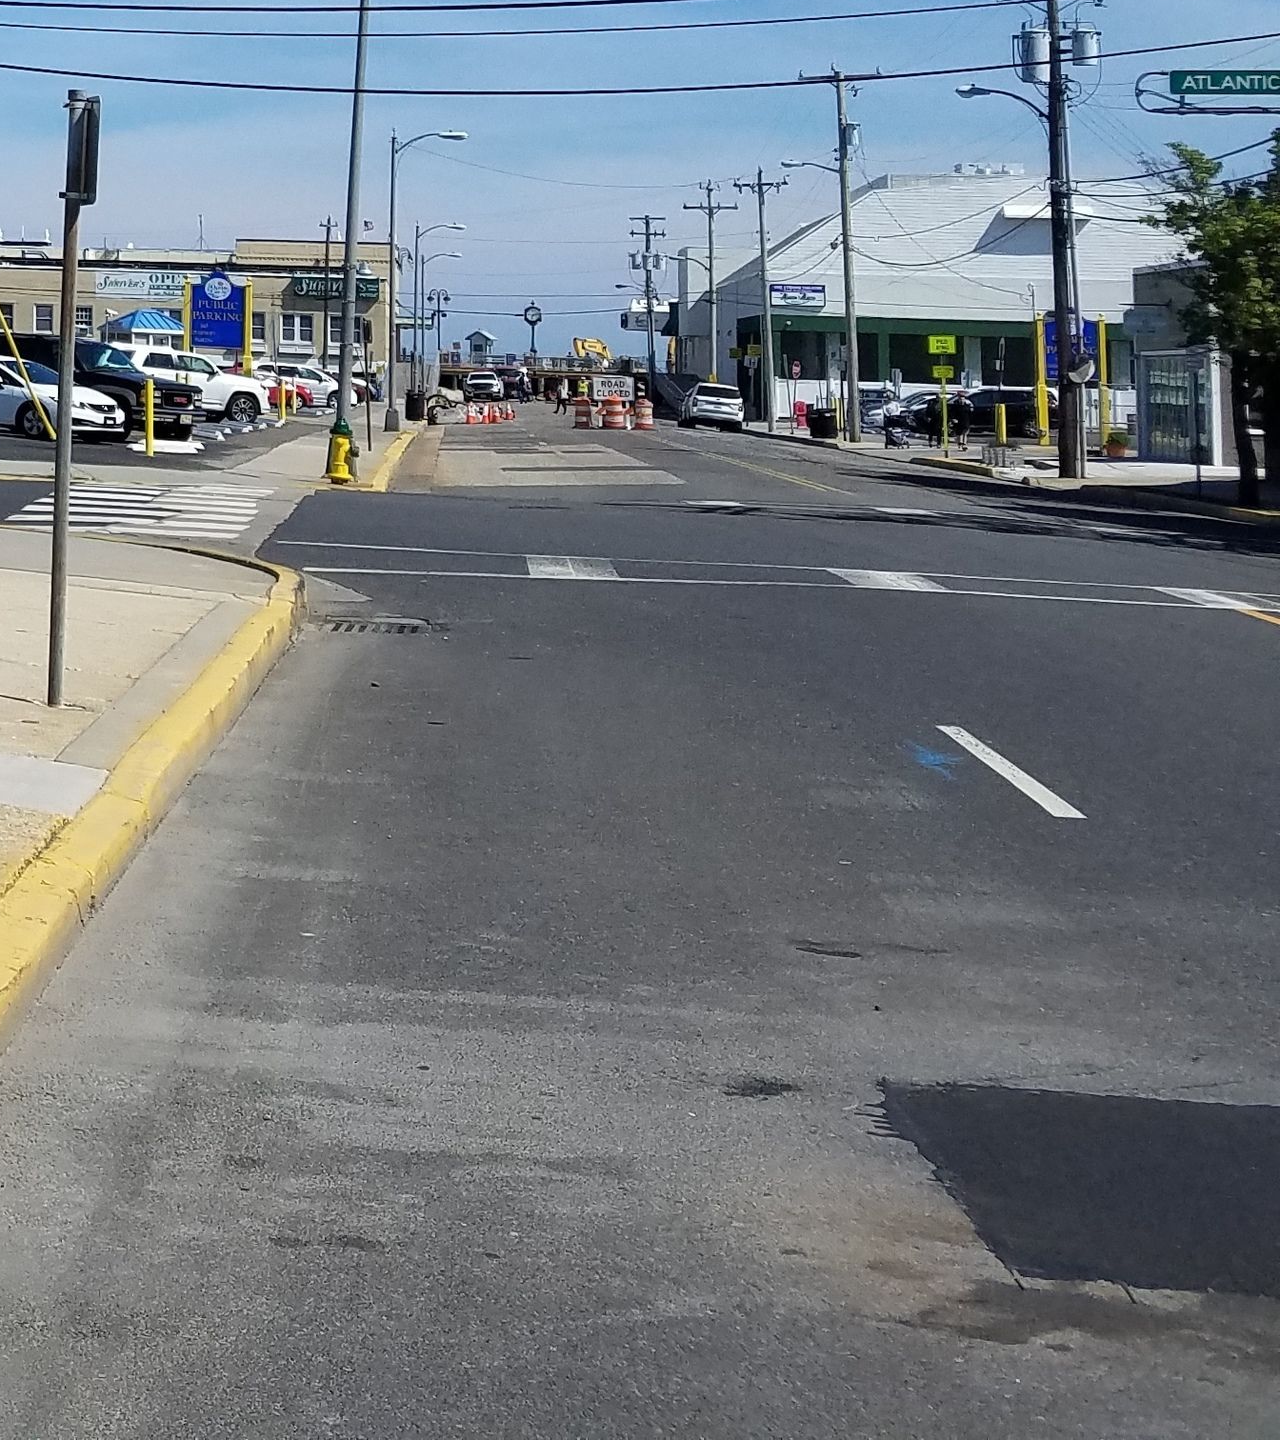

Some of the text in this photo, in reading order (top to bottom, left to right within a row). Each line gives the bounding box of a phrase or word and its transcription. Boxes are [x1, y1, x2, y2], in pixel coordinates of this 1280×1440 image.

[1181, 74, 1280, 90] ATLANTIC
[148, 273, 184, 284] OPE
[295, 278, 366, 295] SHRIV'S
[198, 299, 239, 310] PUBLIC
[601, 380, 625, 388] ROAD
[597, 390, 631, 398] CLOSED
